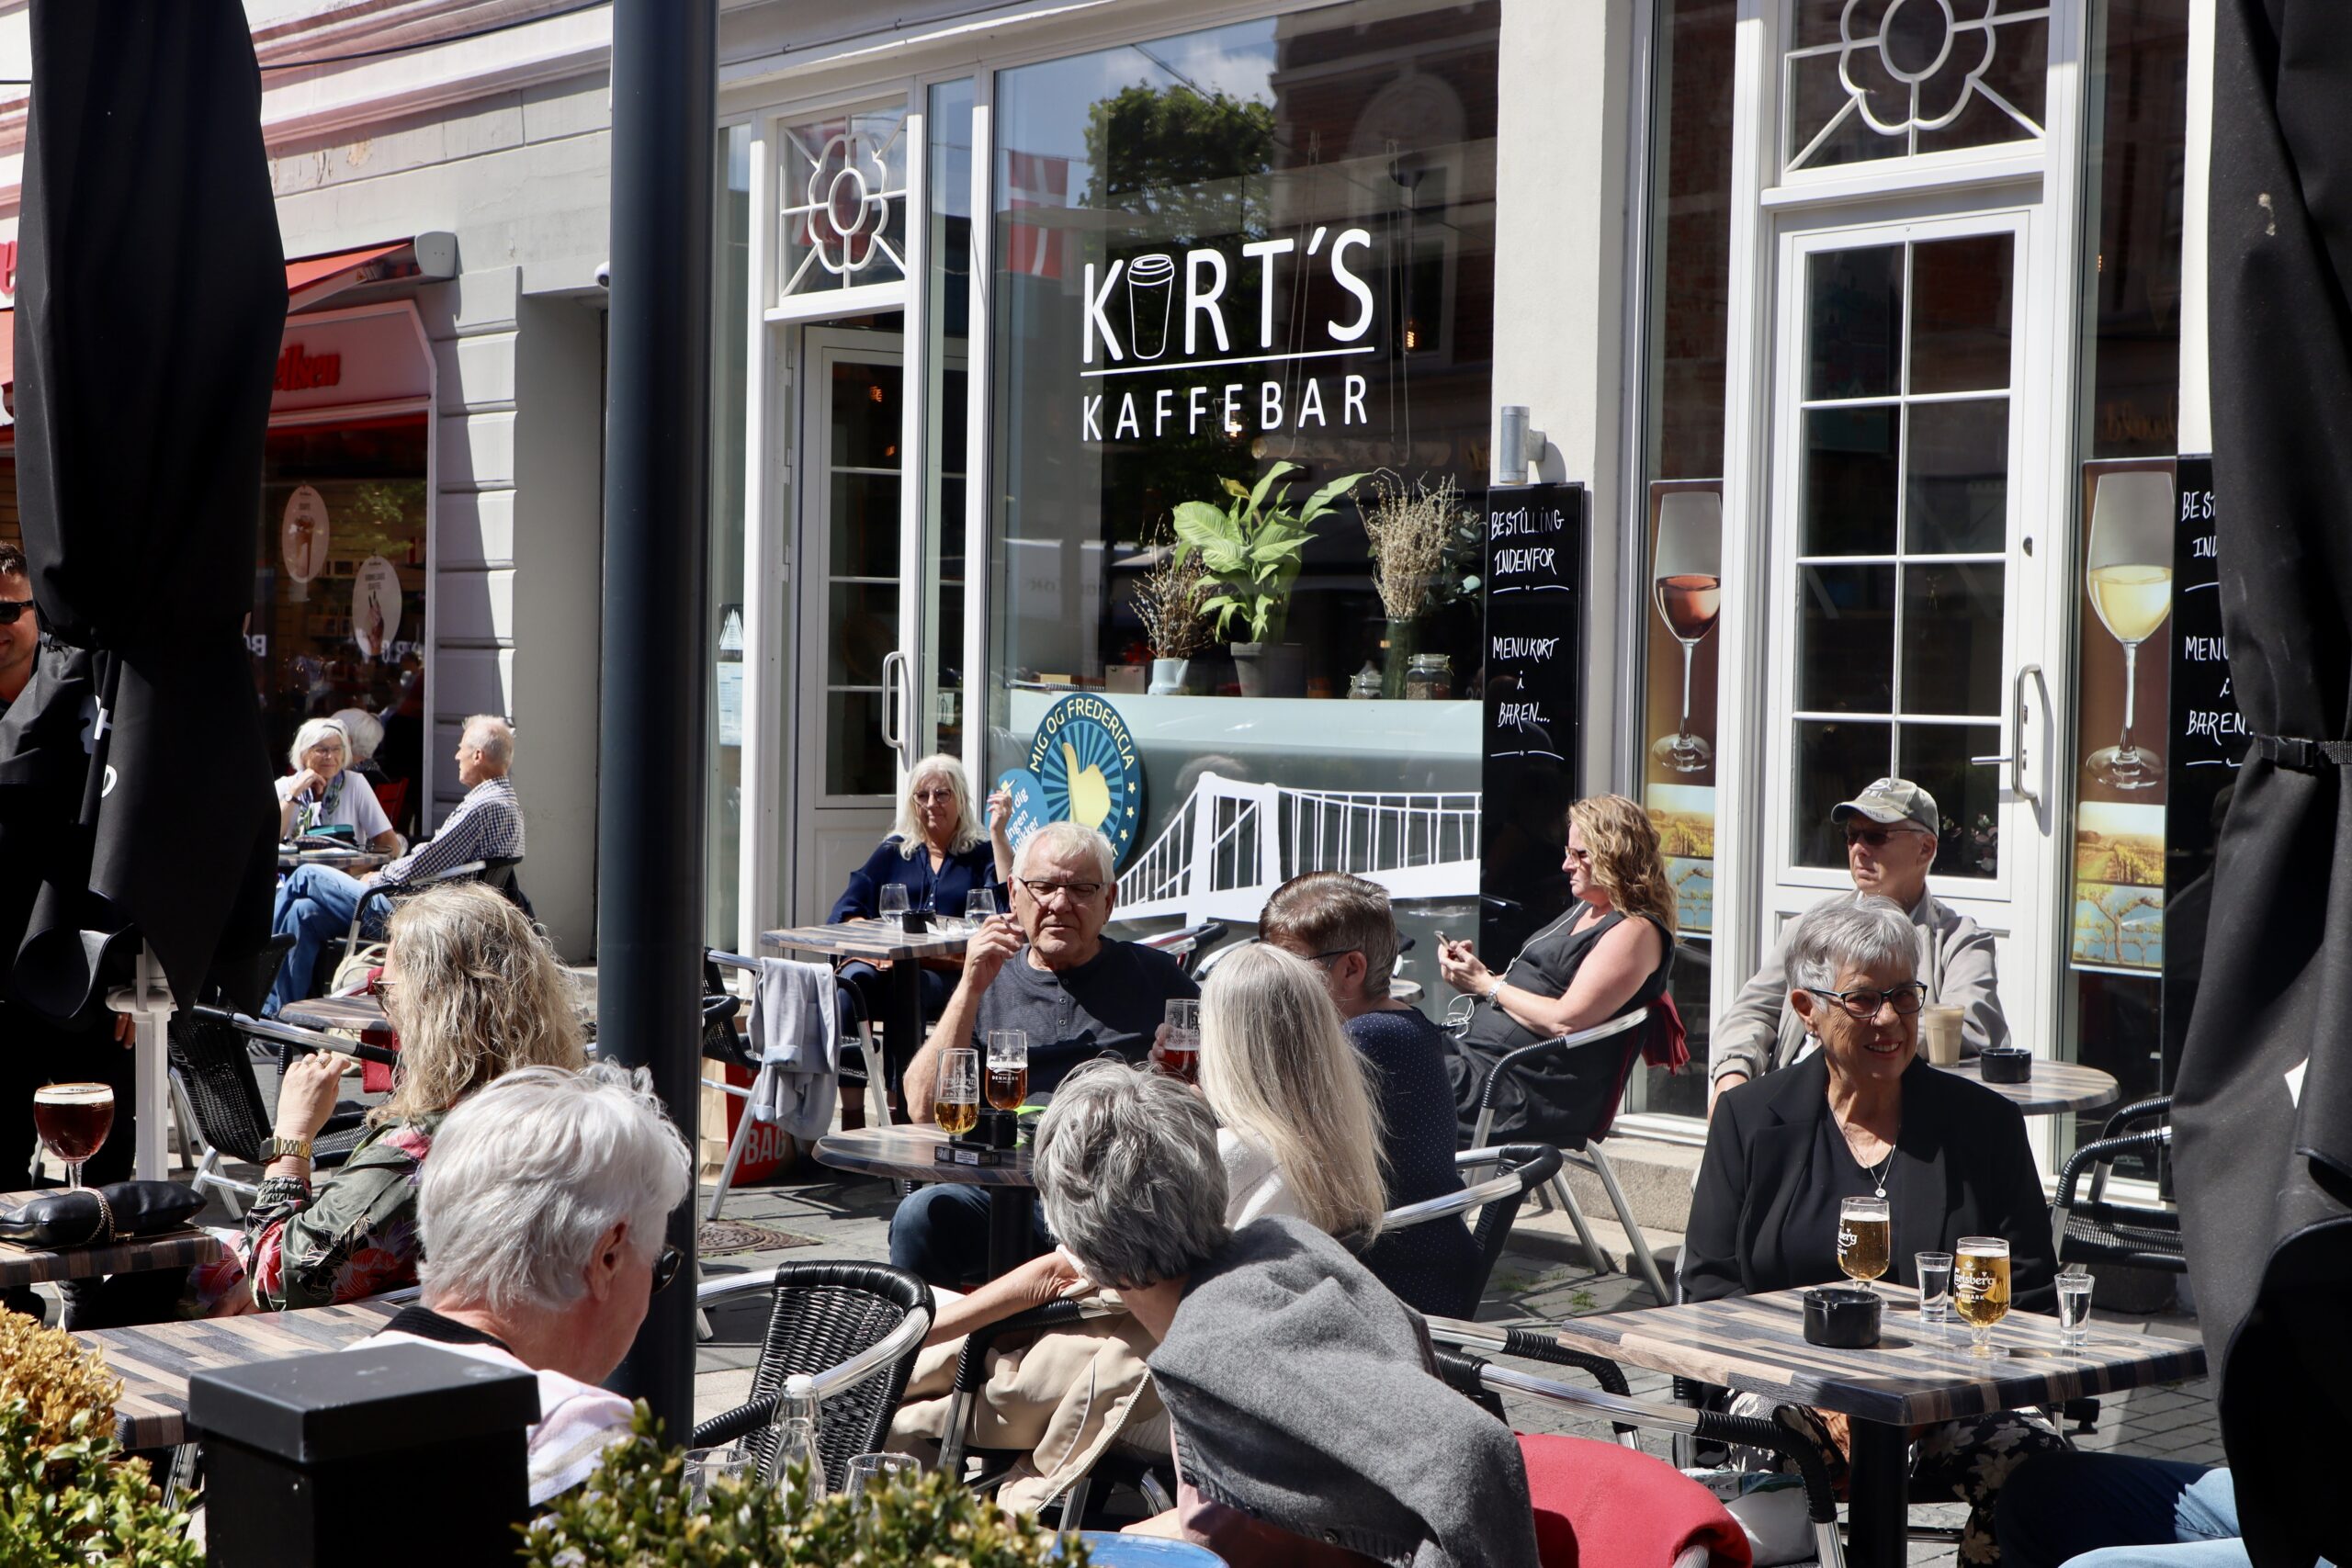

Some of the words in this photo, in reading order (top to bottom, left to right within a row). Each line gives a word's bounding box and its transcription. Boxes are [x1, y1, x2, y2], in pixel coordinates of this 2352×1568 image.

[1082, 374, 1368, 442] KAFFEBAR
[1494, 547, 1557, 576] INDENFOR
[1493, 636, 1560, 663] MENUKORT
[1029, 733, 1049, 773] MIG
[1046, 706, 1065, 734] OG
[1067, 698, 1136, 771] FREDERICIA
